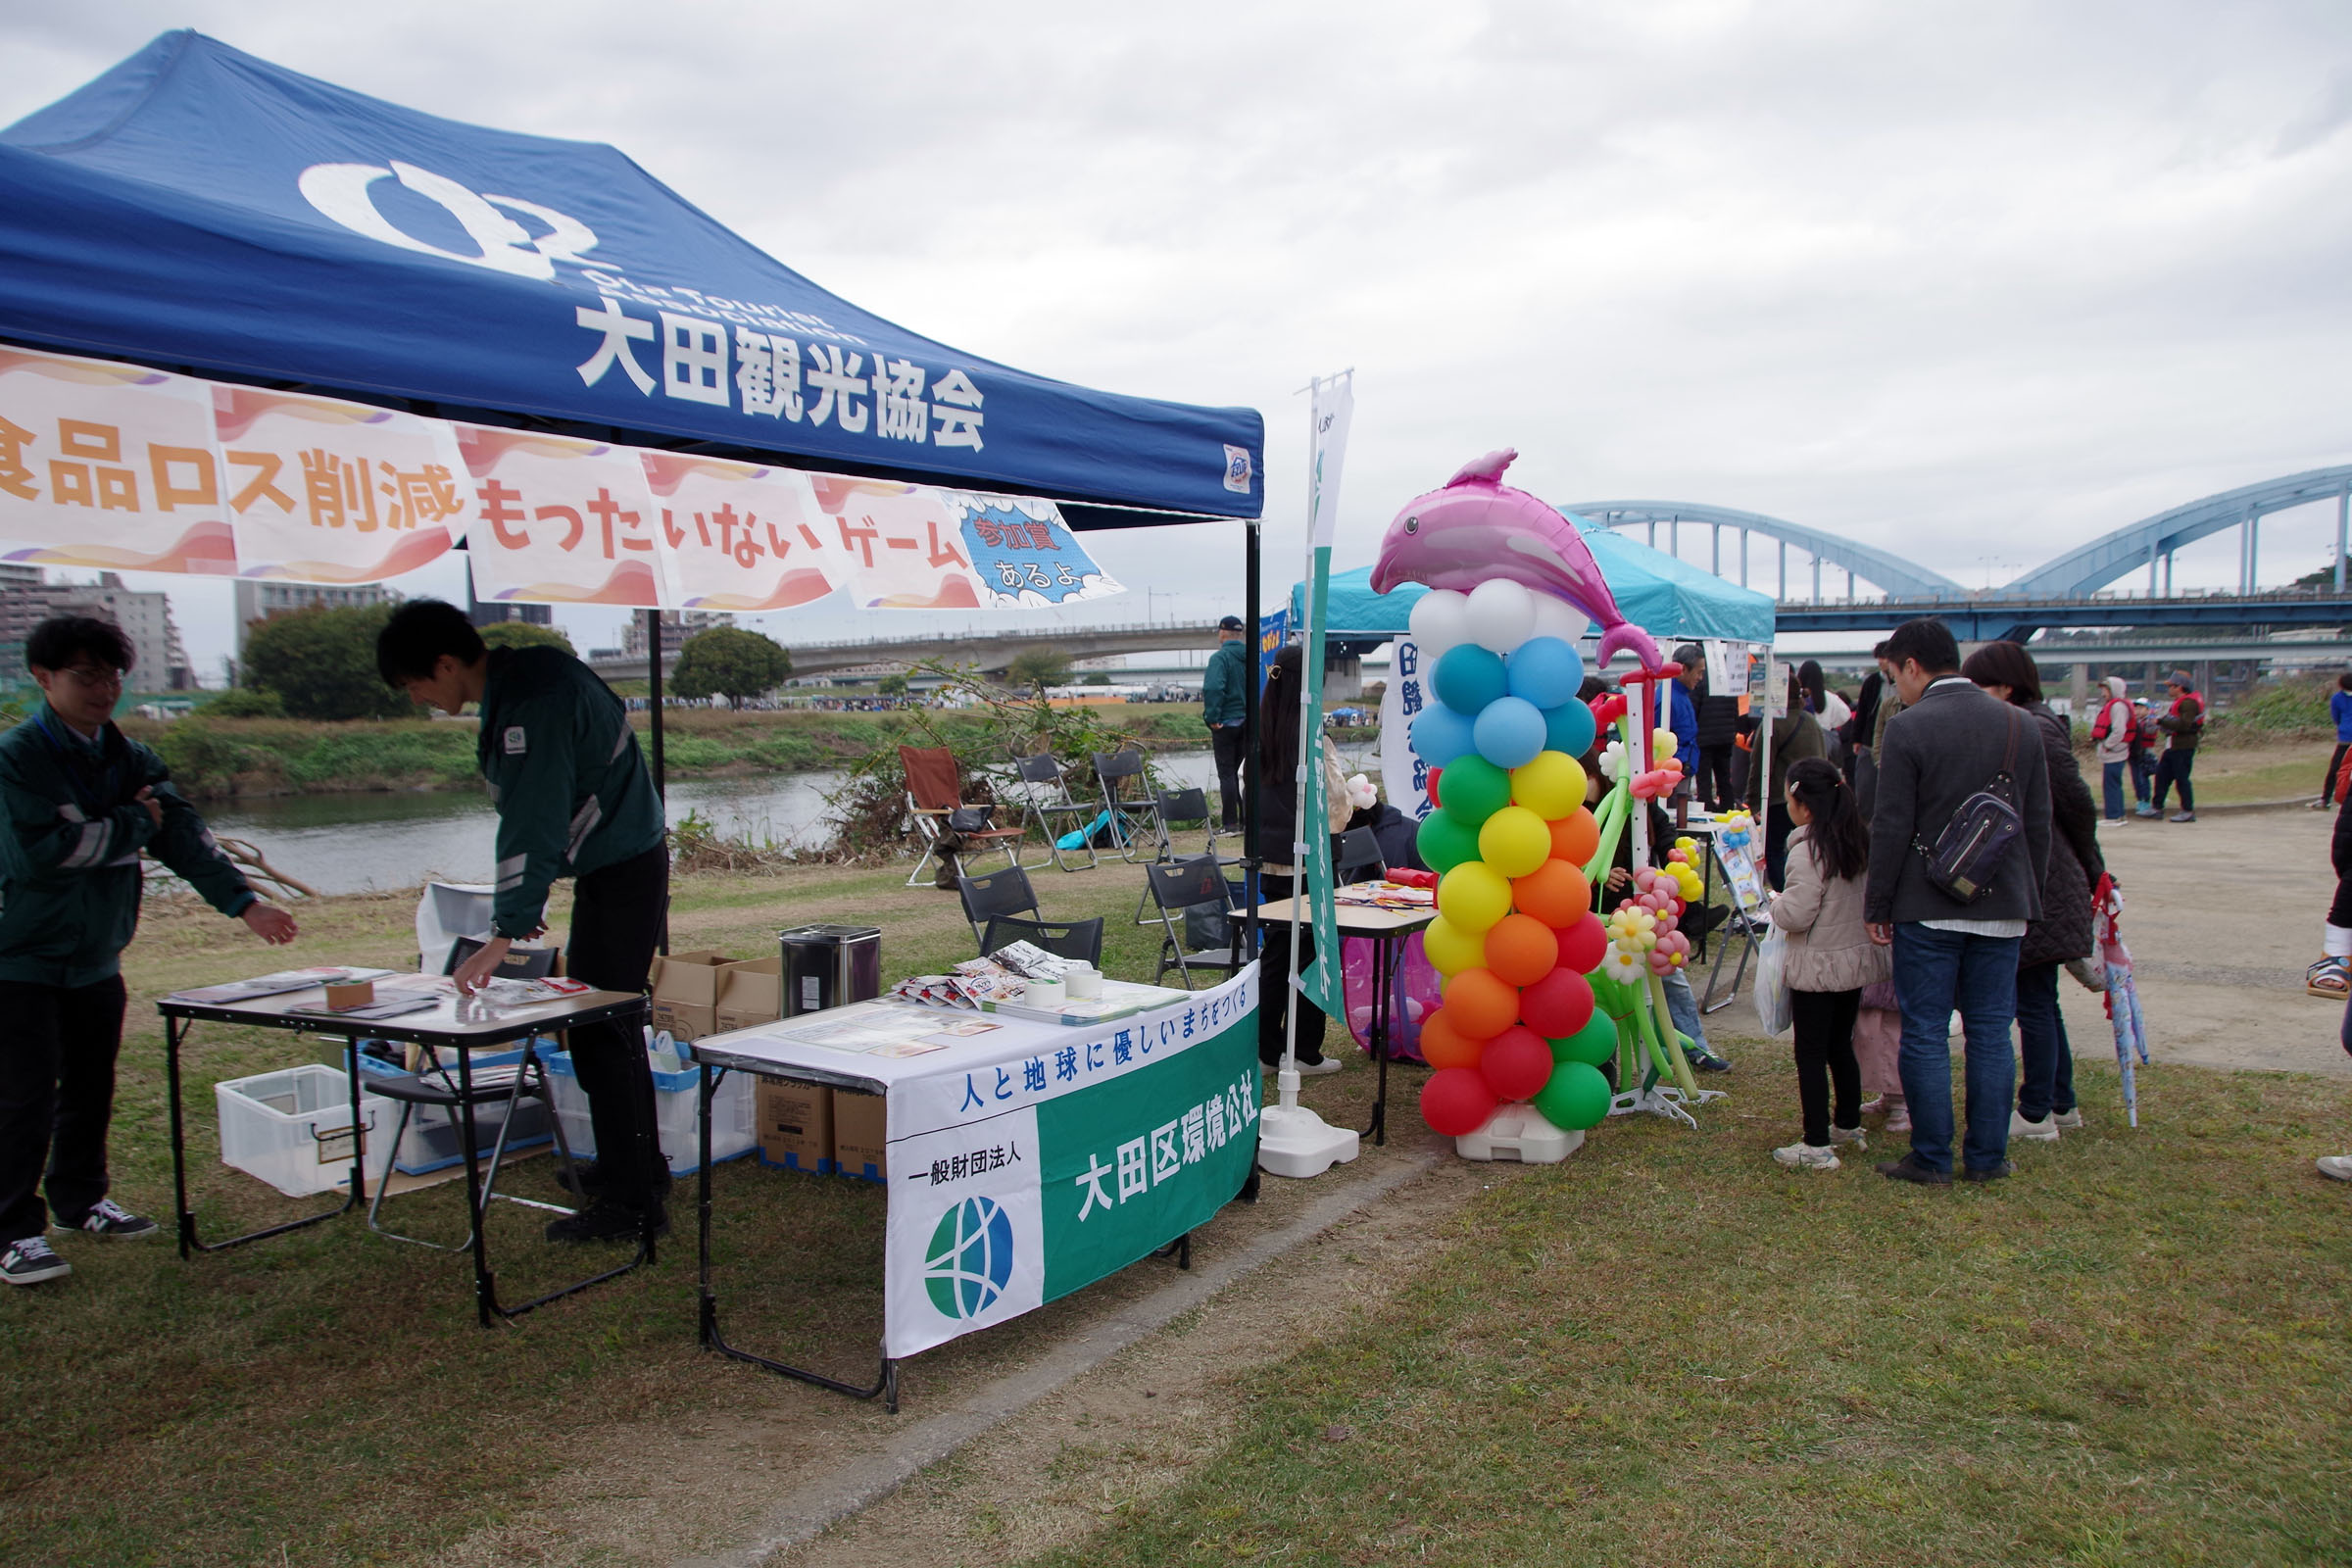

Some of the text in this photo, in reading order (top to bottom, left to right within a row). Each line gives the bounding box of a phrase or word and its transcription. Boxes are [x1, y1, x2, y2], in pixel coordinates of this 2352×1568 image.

[575, 296, 985, 452] 大田観光協会
[480, 478, 969, 569] もったいないゲーム
[972, 516, 1061, 551] 参加賞
[994, 560, 1083, 588] あるよ
[959, 984, 1247, 1113] 人と地球に優しいまちをつくる
[907, 1140, 1022, 1188] 一般財団法人
[1074, 1069, 1259, 1223] 大田区環境公社
